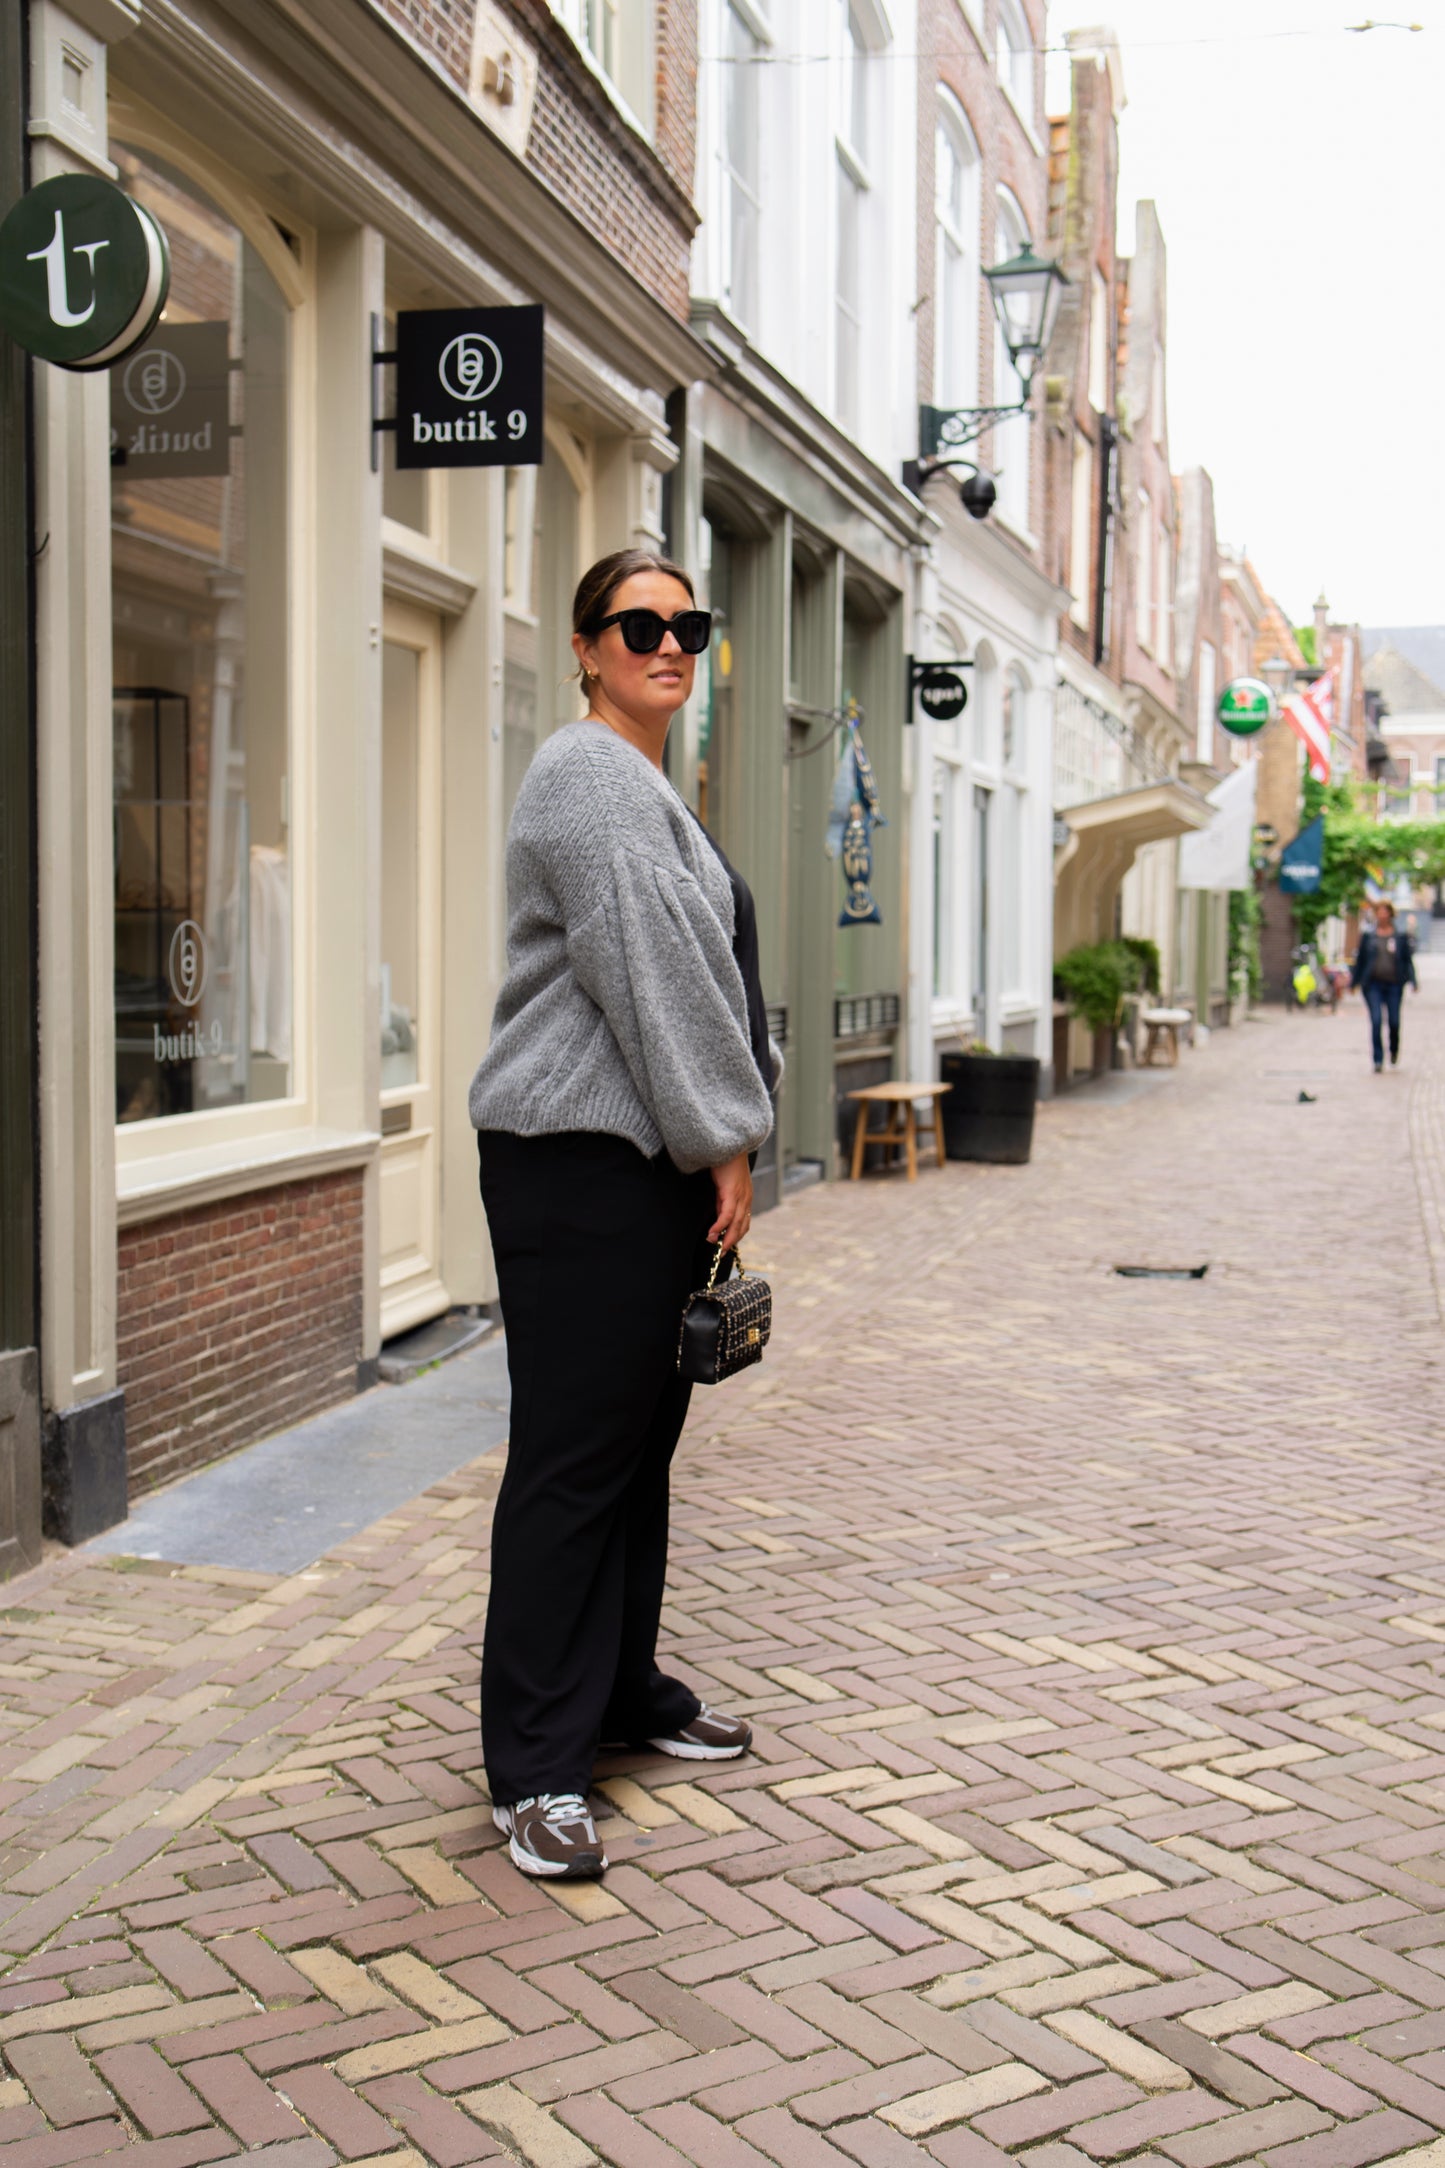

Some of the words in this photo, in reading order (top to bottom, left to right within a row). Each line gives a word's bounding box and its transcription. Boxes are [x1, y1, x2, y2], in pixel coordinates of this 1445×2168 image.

[412, 410, 497, 443] butik
[507, 409, 527, 440] 9
[153, 1020, 205, 1062] butik
[210, 1018, 222, 1057] 9
